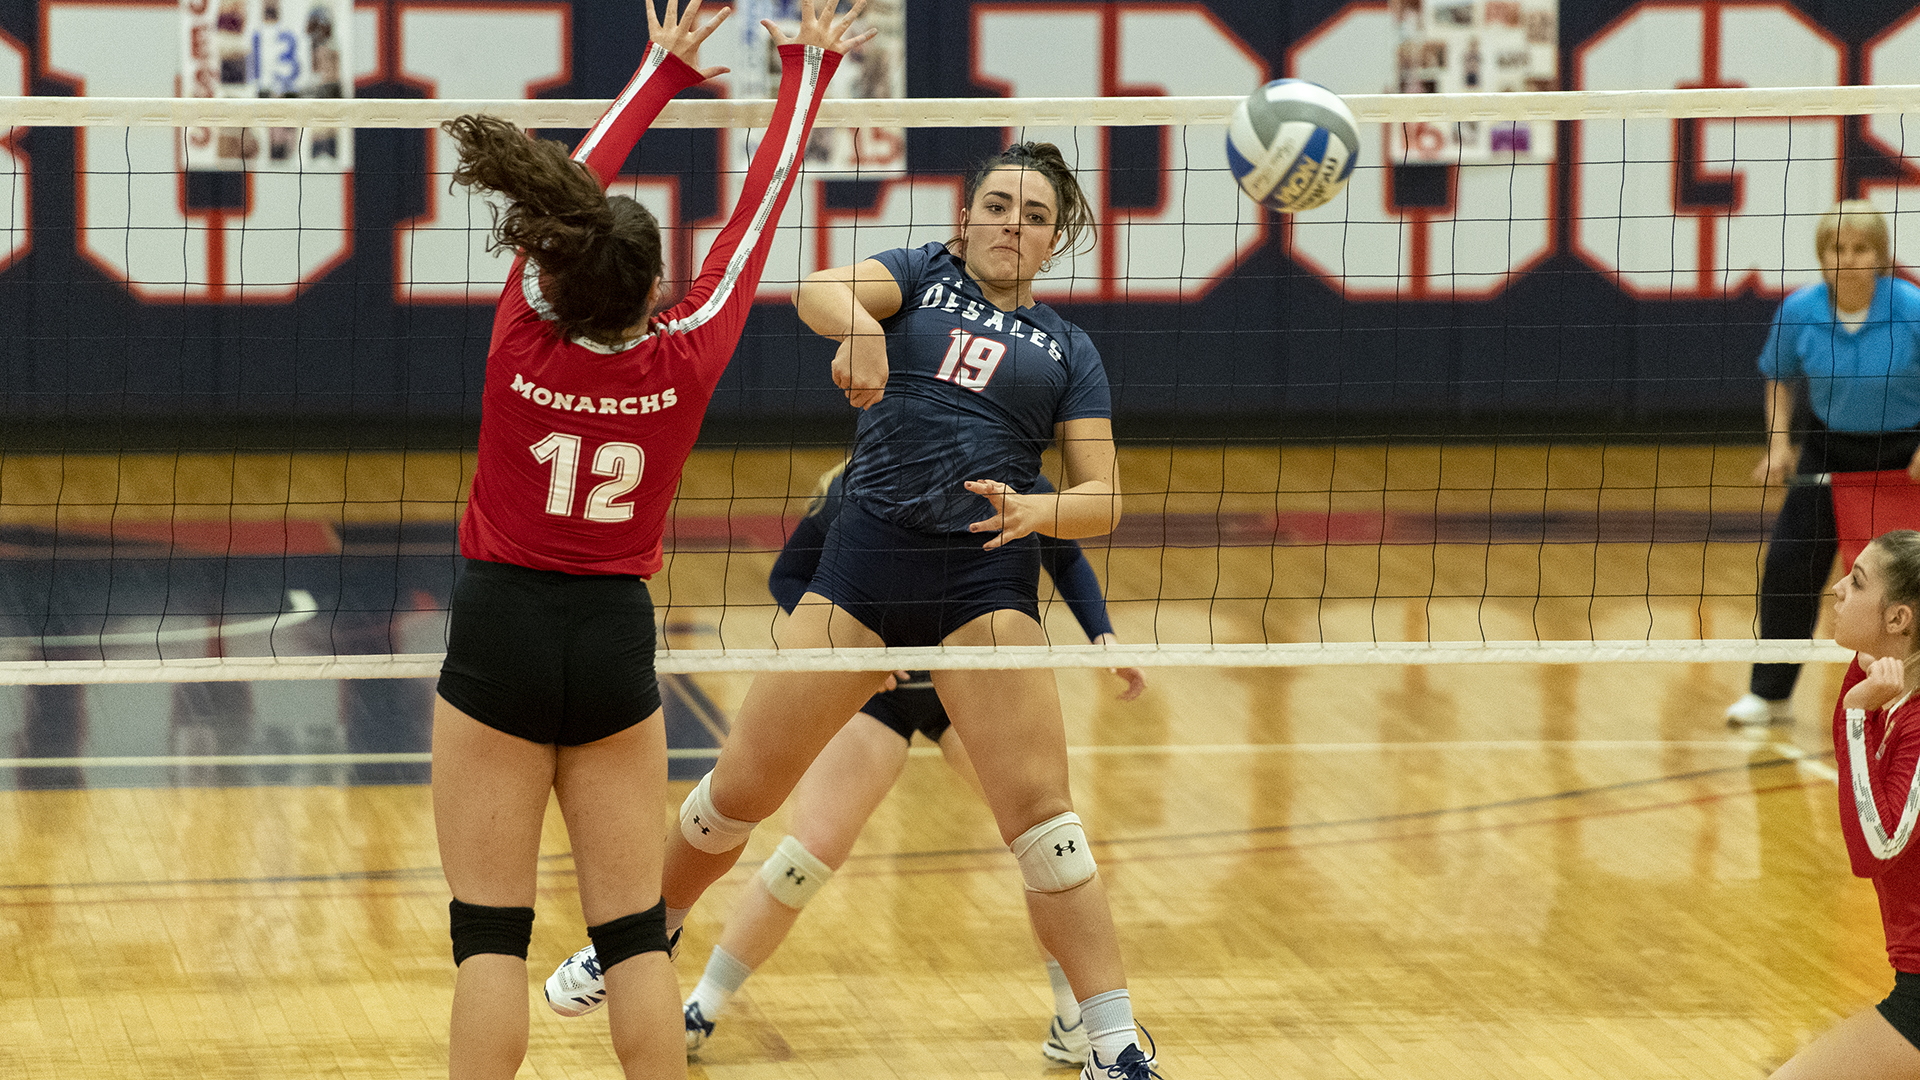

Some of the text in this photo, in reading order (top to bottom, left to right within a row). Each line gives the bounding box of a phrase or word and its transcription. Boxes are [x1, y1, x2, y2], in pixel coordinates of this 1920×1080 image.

[248, 29, 301, 93] 13
[0, 2, 1920, 304] ULLDOG
[918, 282, 1064, 363] DESALES
[510, 373, 678, 415] MONARCHS
[934, 327, 1008, 393] 19
[529, 431, 646, 524] 12
